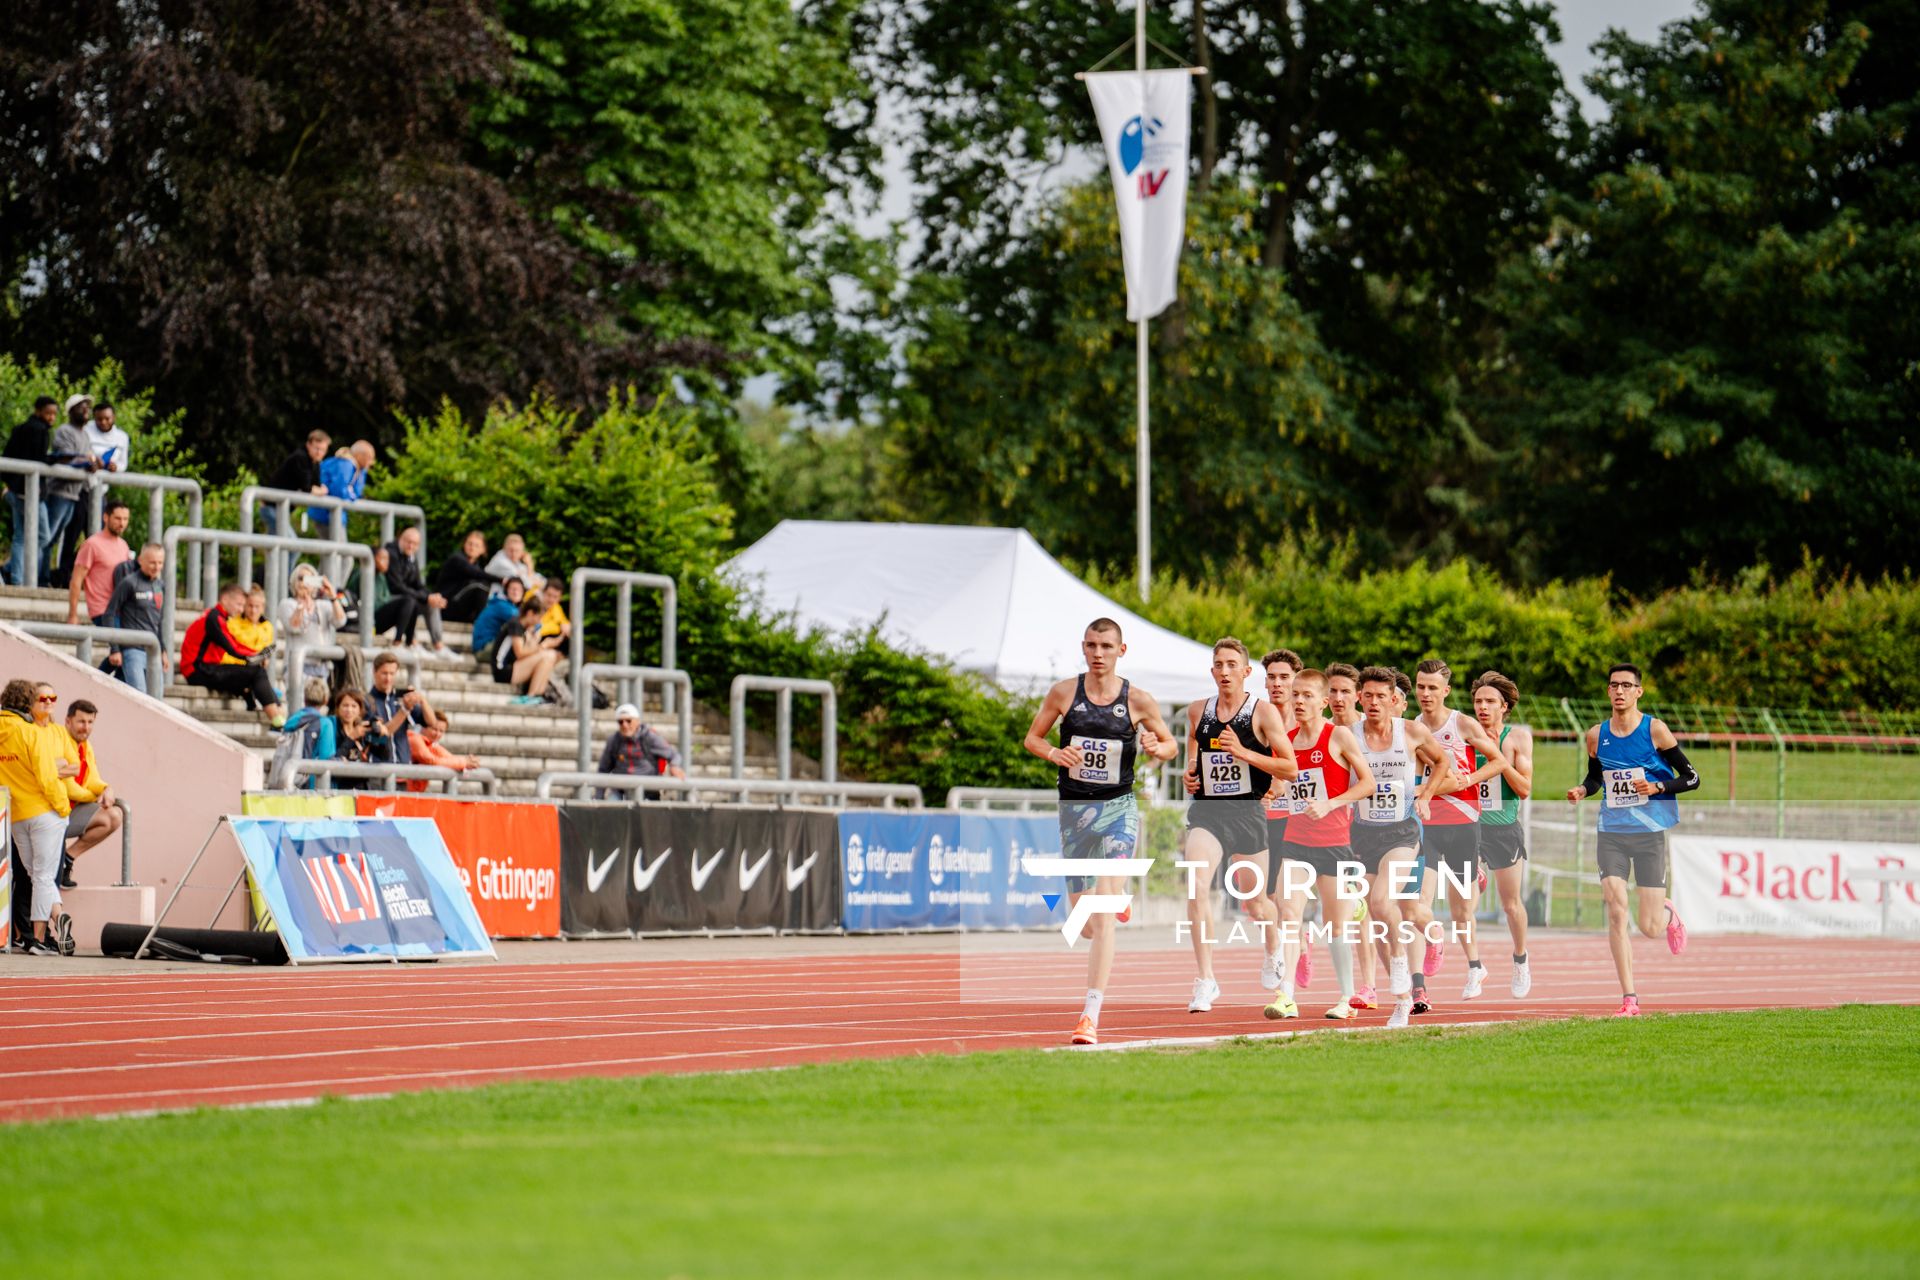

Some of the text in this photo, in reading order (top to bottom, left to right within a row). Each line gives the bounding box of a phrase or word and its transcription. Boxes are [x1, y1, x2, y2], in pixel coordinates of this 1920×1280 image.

[1082, 740, 1107, 752] GLS
[1084, 752, 1106, 774] 98
[1210, 754, 1233, 764] GLS
[1210, 765, 1241, 781] 428
[1296, 771, 1310, 782] LS
[1612, 771, 1632, 780] GLS
[1291, 782, 1317, 800] 367
[1377, 783, 1392, 793] LS
[1367, 794, 1397, 809] 153
[1719, 851, 1858, 902] Black
